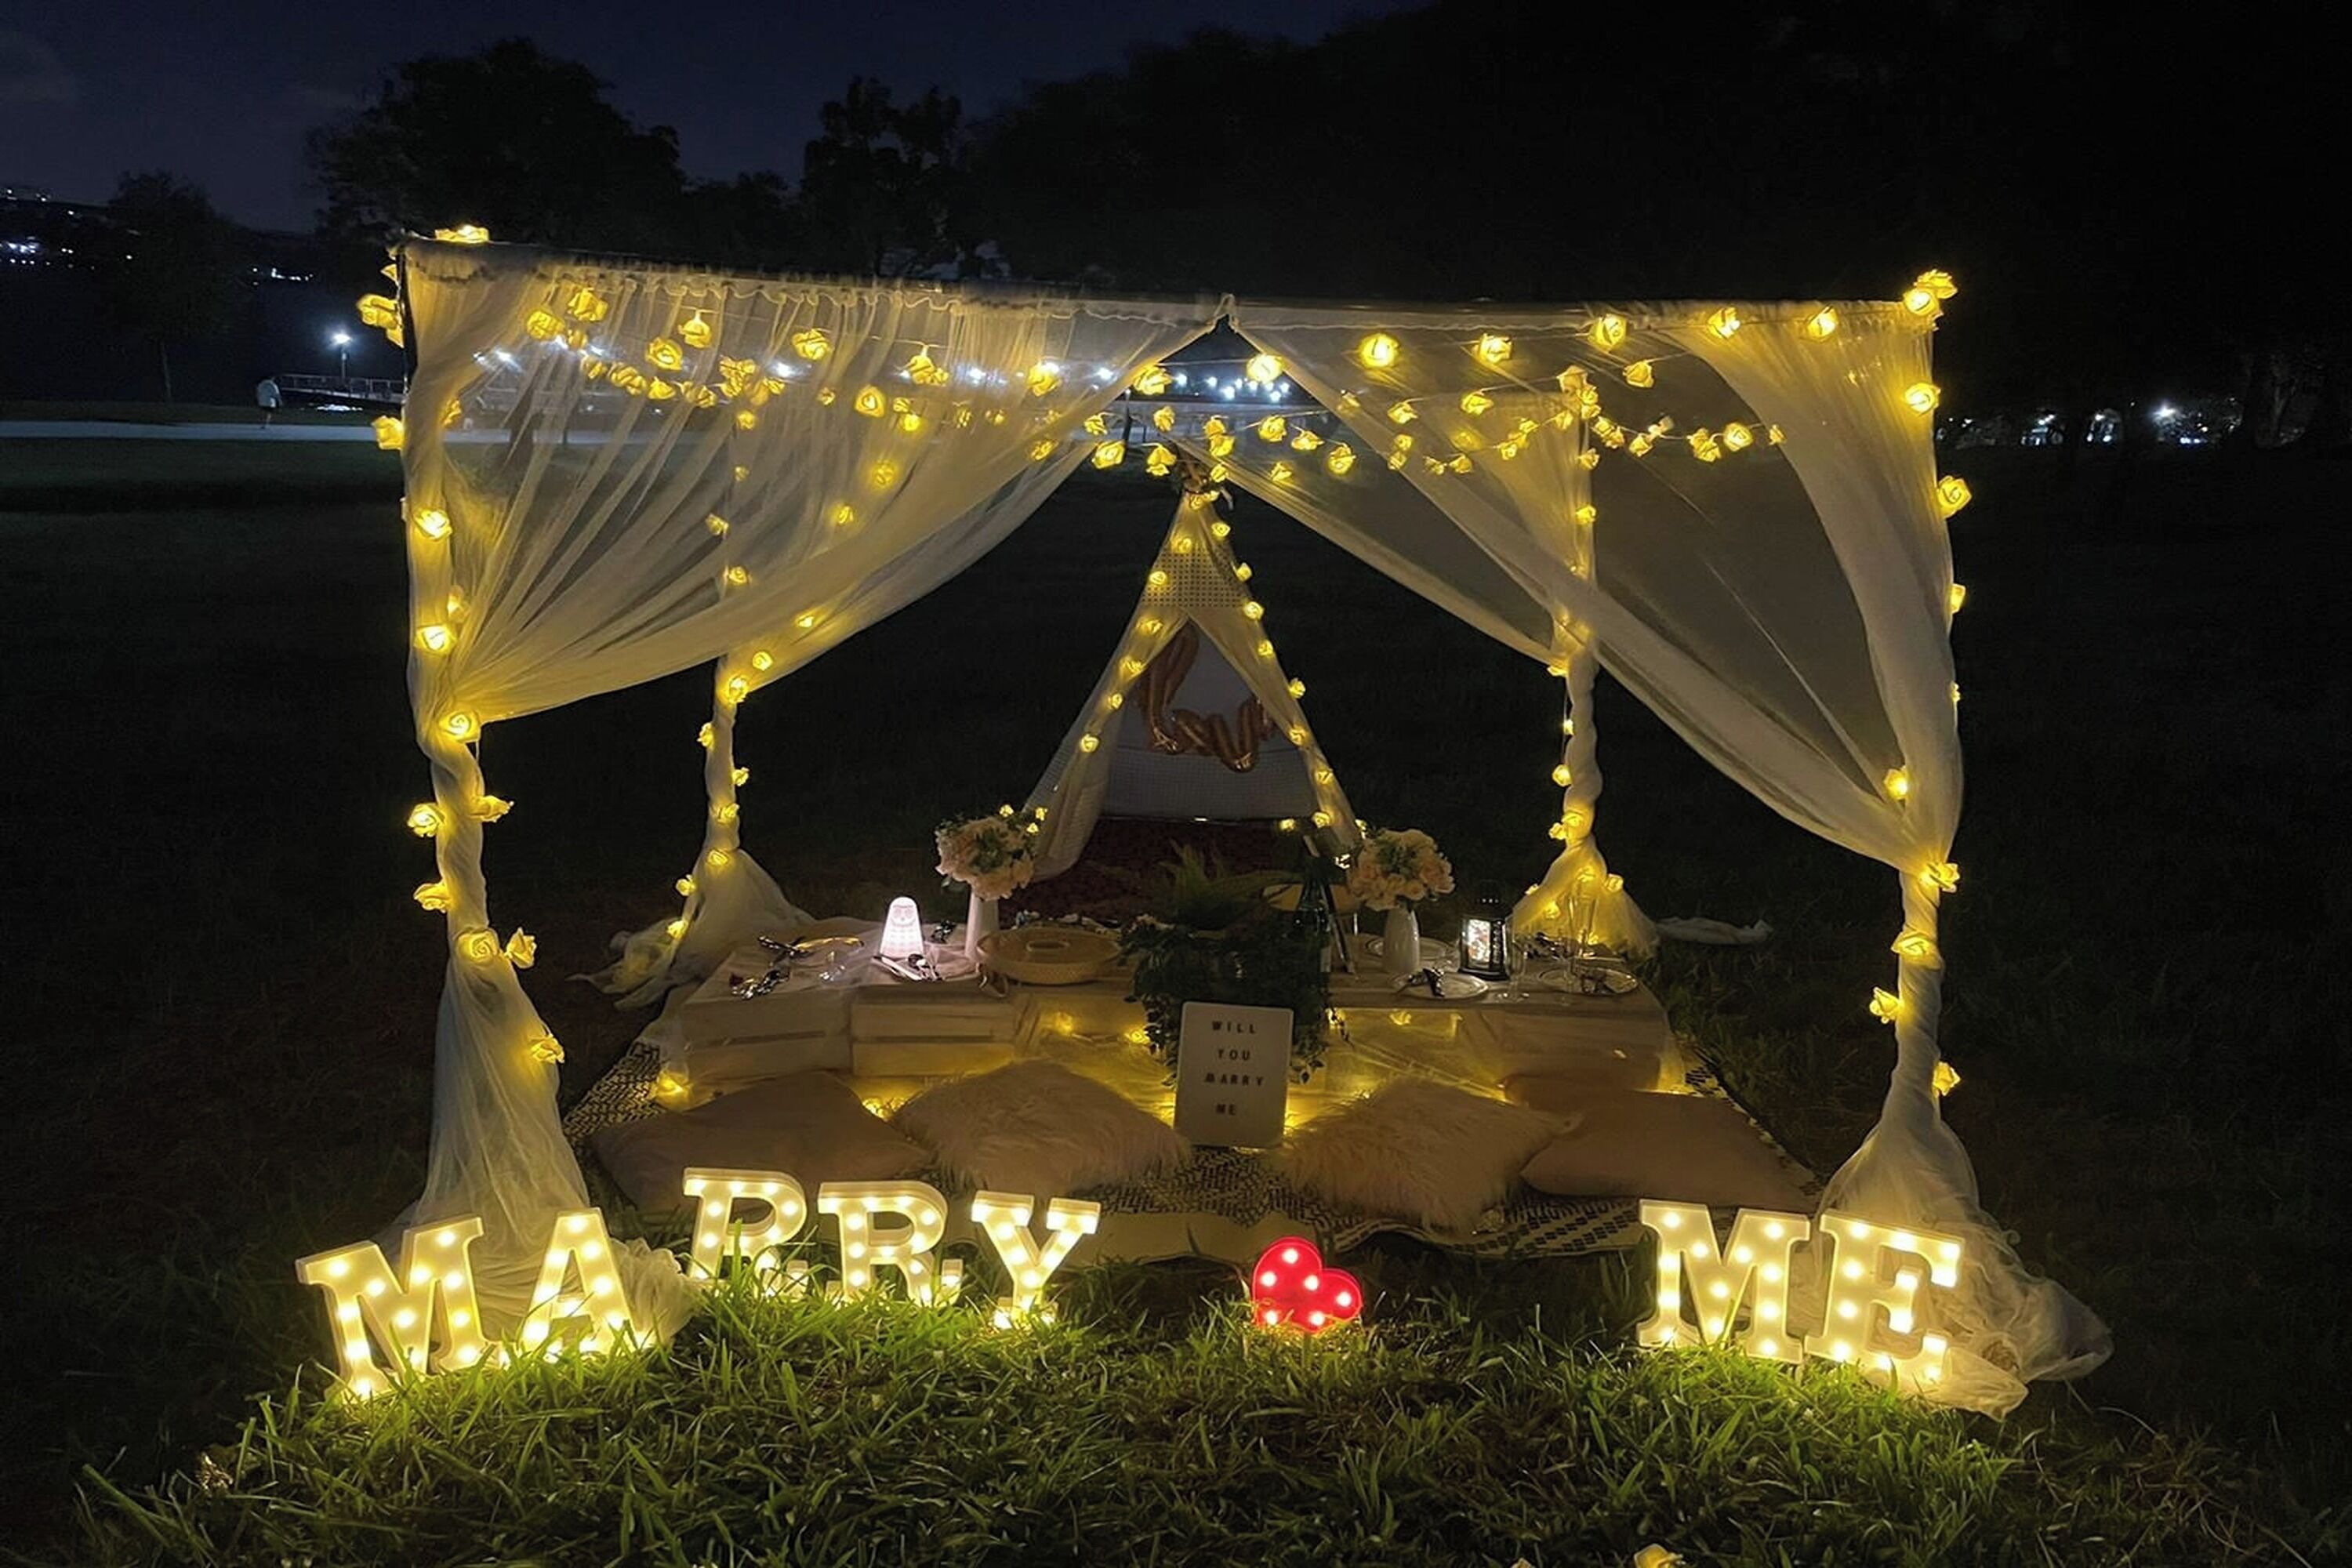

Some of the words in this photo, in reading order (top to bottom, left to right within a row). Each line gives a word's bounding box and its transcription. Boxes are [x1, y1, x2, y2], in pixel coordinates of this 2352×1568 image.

[1212, 1021, 1256, 1034] WILL
[1218, 1049, 1251, 1061] YOU
[1204, 1073, 1265, 1087] MARRY
[1216, 1103, 1236, 1116] ME
[296, 1167, 1101, 1403] MARRY
[1636, 1199, 1965, 1387] ME
